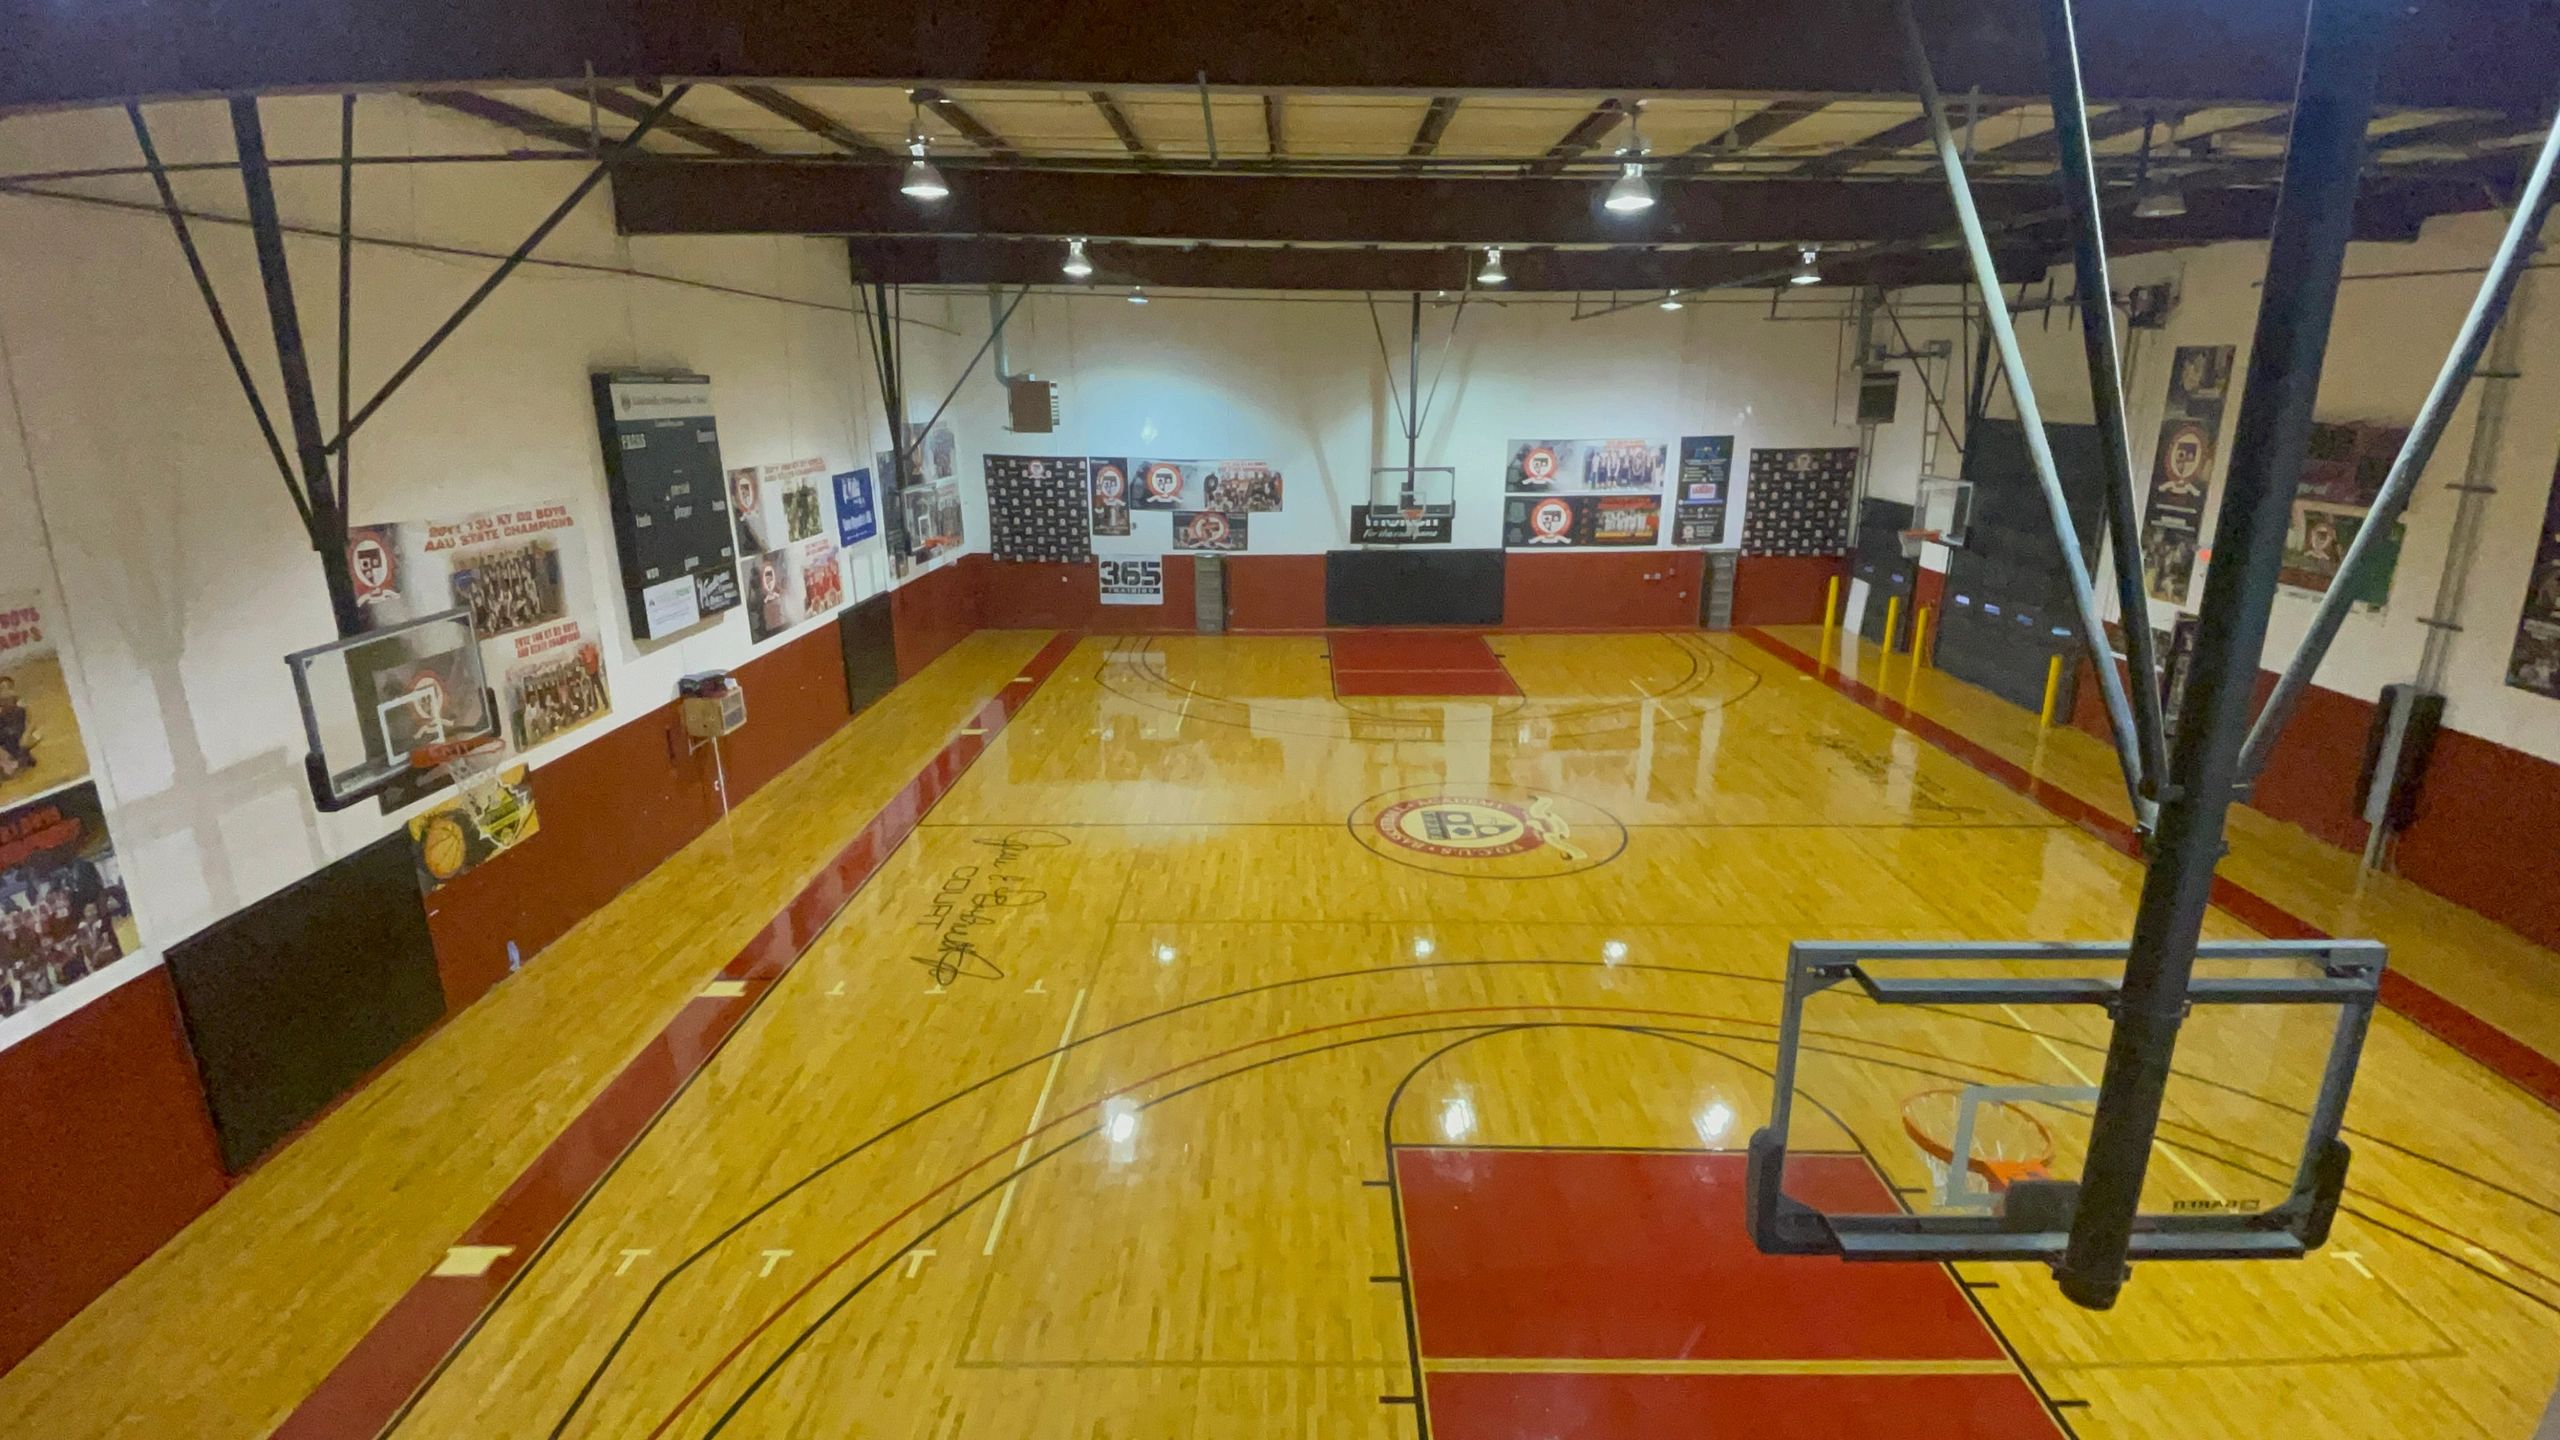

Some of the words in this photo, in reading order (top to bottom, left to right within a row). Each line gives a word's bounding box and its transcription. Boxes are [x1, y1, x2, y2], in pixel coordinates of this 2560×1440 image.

[536, 505, 567, 519] BOYS
[424, 538, 456, 552] AAU
[460, 530, 500, 546] STATE
[504, 516, 574, 537] CHAMPIONS
[1100, 561, 1161, 586] 365
[915, 866, 979, 931] COURT
